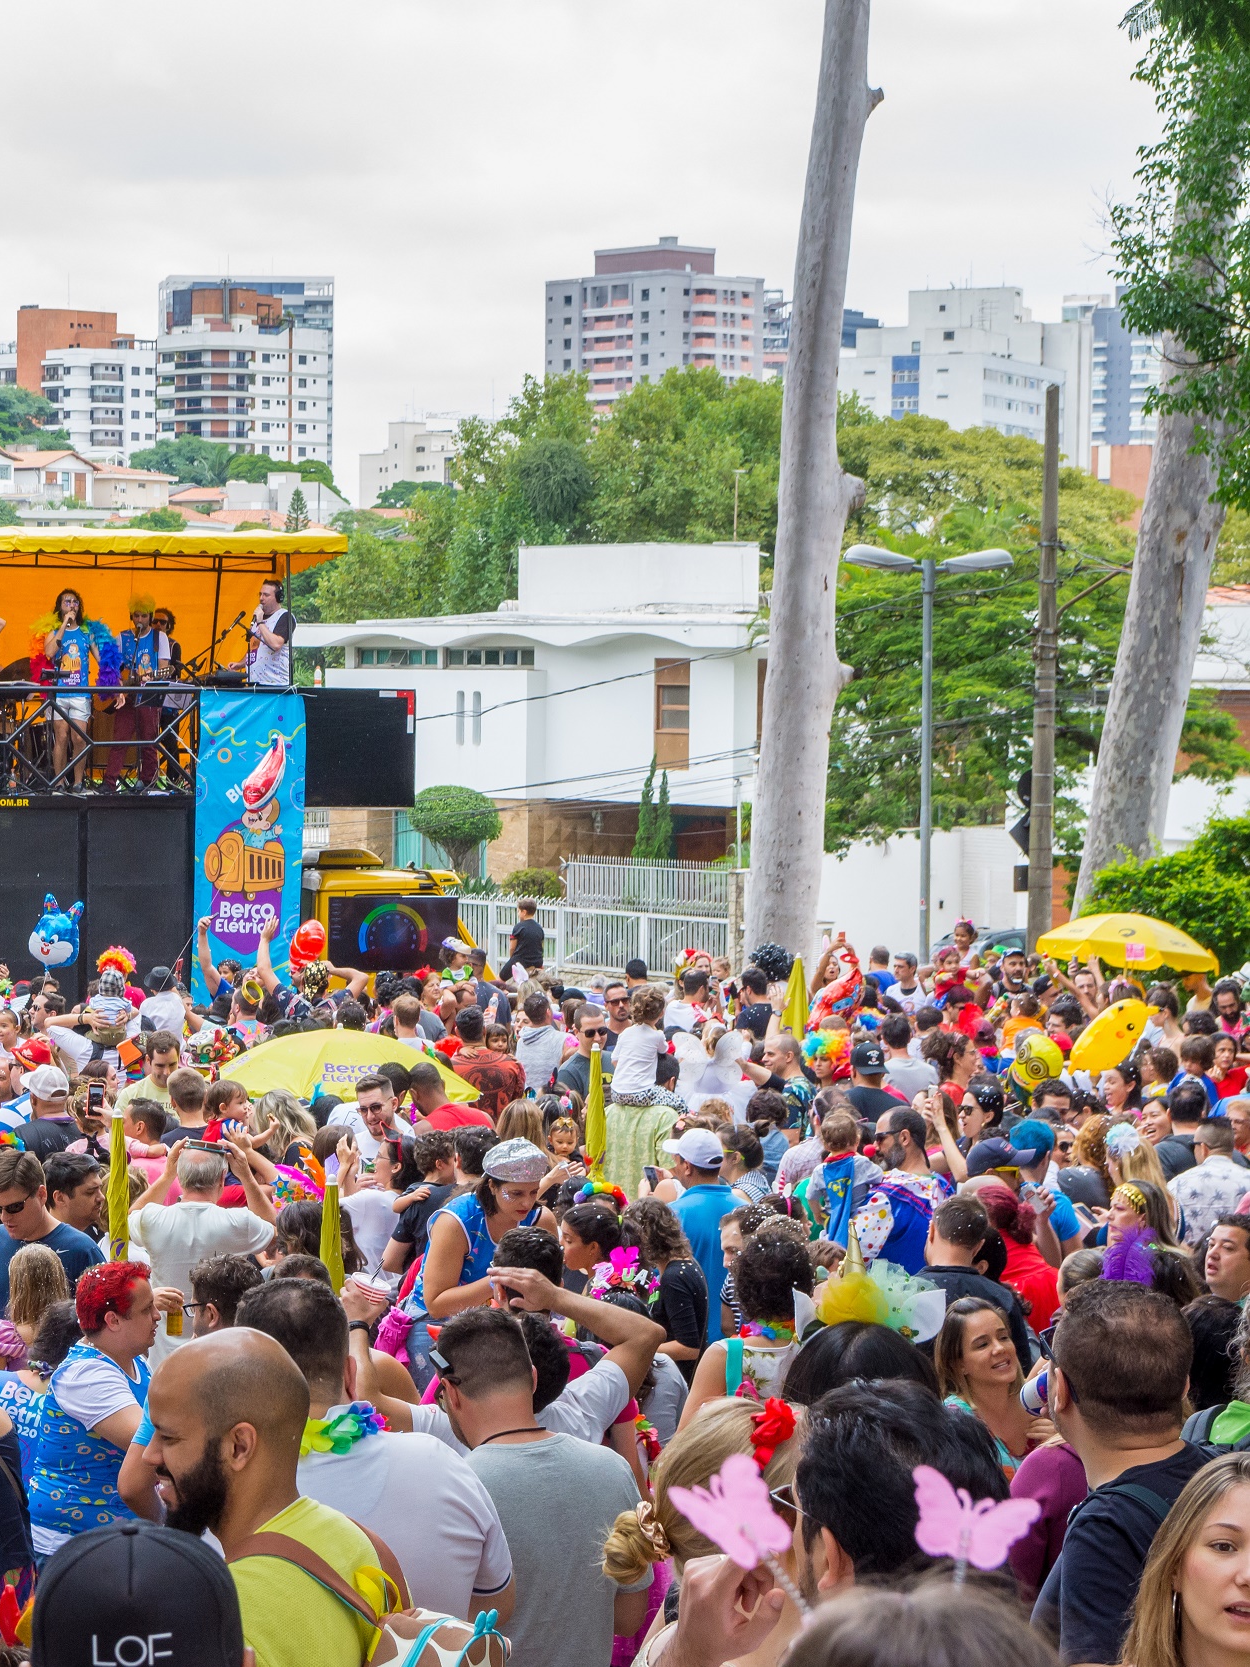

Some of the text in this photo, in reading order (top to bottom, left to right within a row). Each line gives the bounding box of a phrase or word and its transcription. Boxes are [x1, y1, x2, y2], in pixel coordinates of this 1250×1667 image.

[219, 901, 276, 923] Berço
[215, 918, 266, 934] Elétric
[321, 1073, 362, 1083] Elétr
[92, 1632, 173, 1667] LOF
